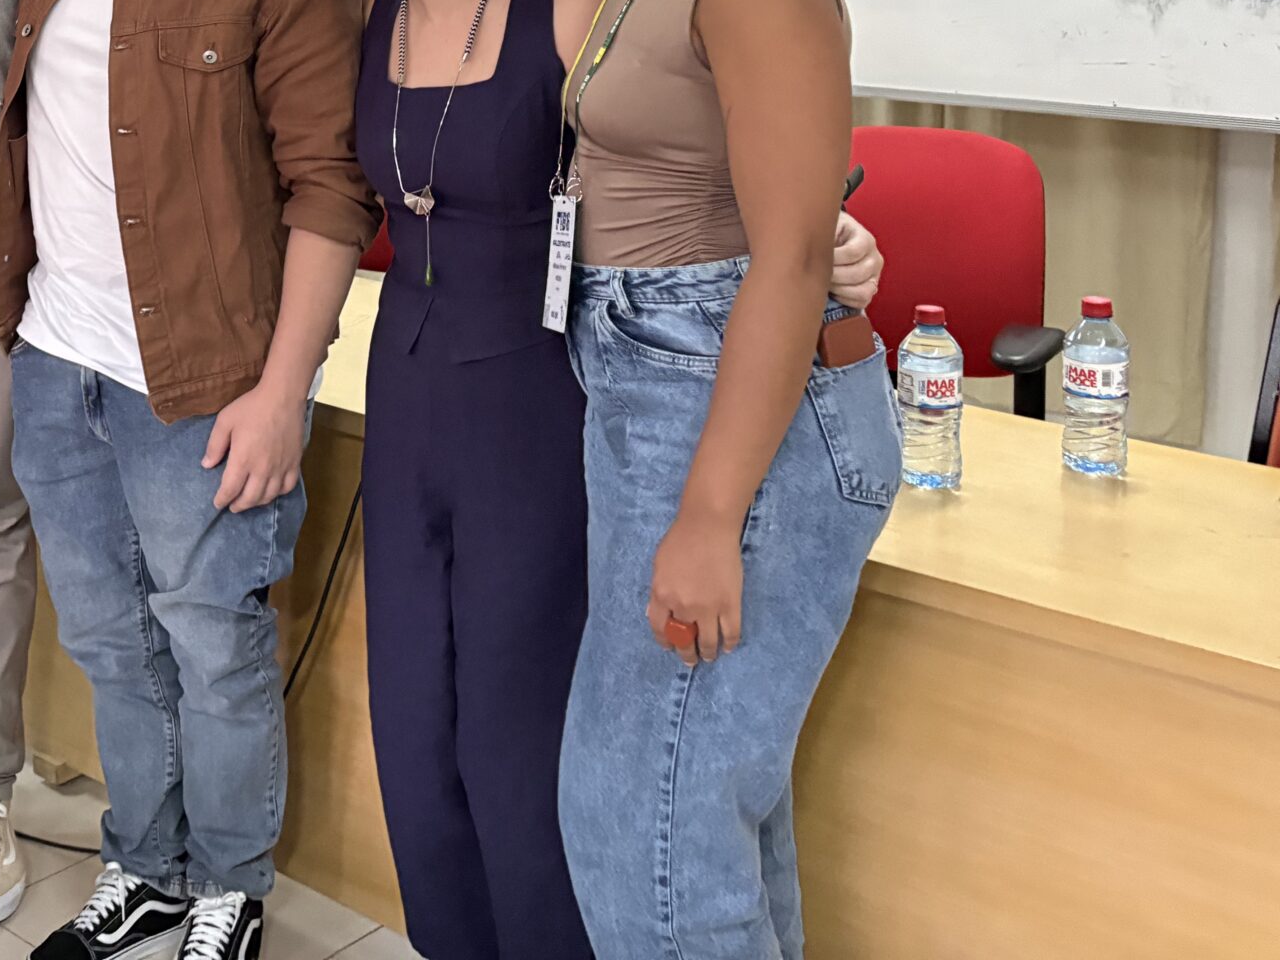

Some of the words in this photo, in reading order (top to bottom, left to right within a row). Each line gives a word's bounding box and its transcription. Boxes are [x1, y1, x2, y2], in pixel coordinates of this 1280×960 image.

[1069, 365, 1097, 381] MAR
[926, 378, 956, 390] MAR
[1069, 375, 1098, 388] DOCE
[926, 388, 956, 399] DOCE
